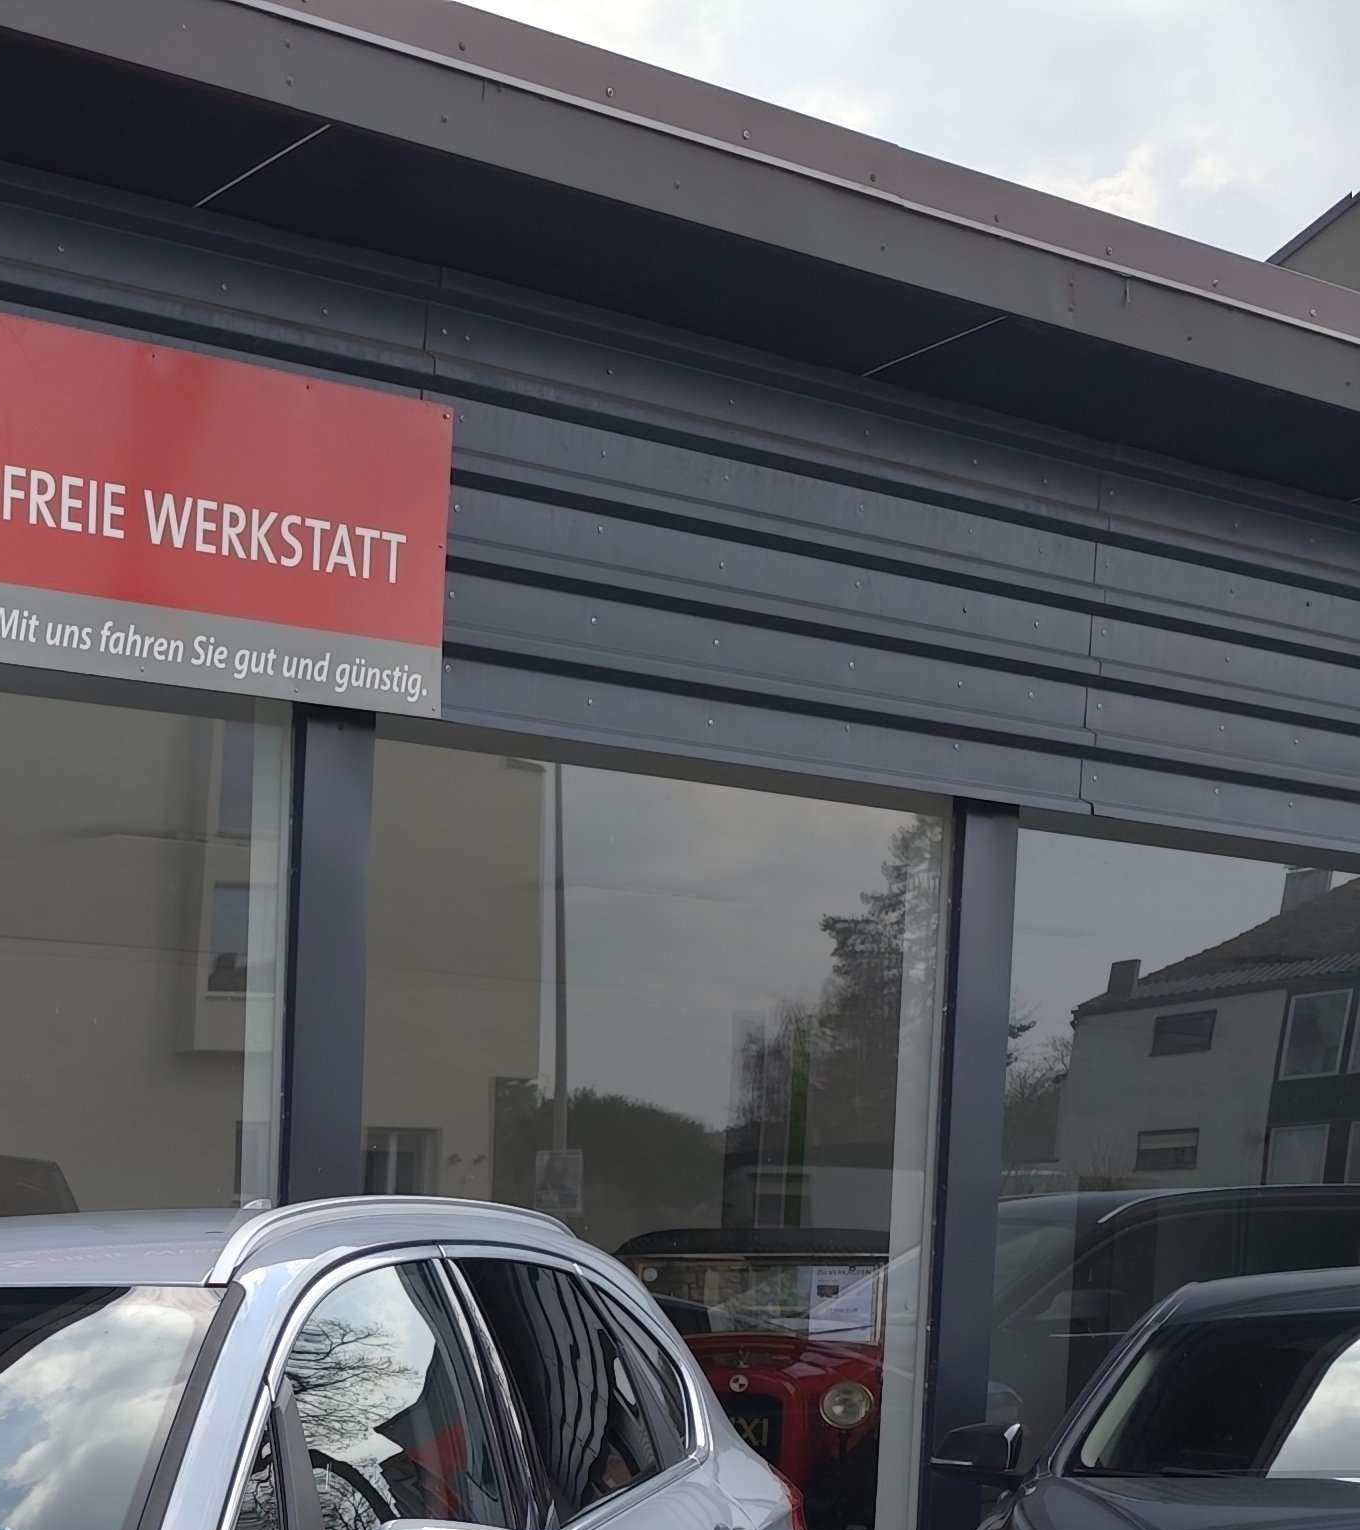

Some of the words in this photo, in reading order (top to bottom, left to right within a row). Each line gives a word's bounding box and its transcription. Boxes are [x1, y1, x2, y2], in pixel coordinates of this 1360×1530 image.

[2, 464, 126, 540] FREIE
[144, 487, 408, 585] WERKSTATT
[45, 620, 93, 655] uns
[98, 618, 184, 667] fahren
[191, 634, 229, 673] Sie
[233, 642, 277, 688] gut
[281, 652, 330, 685] und
[334, 655, 429, 702] günstig.
